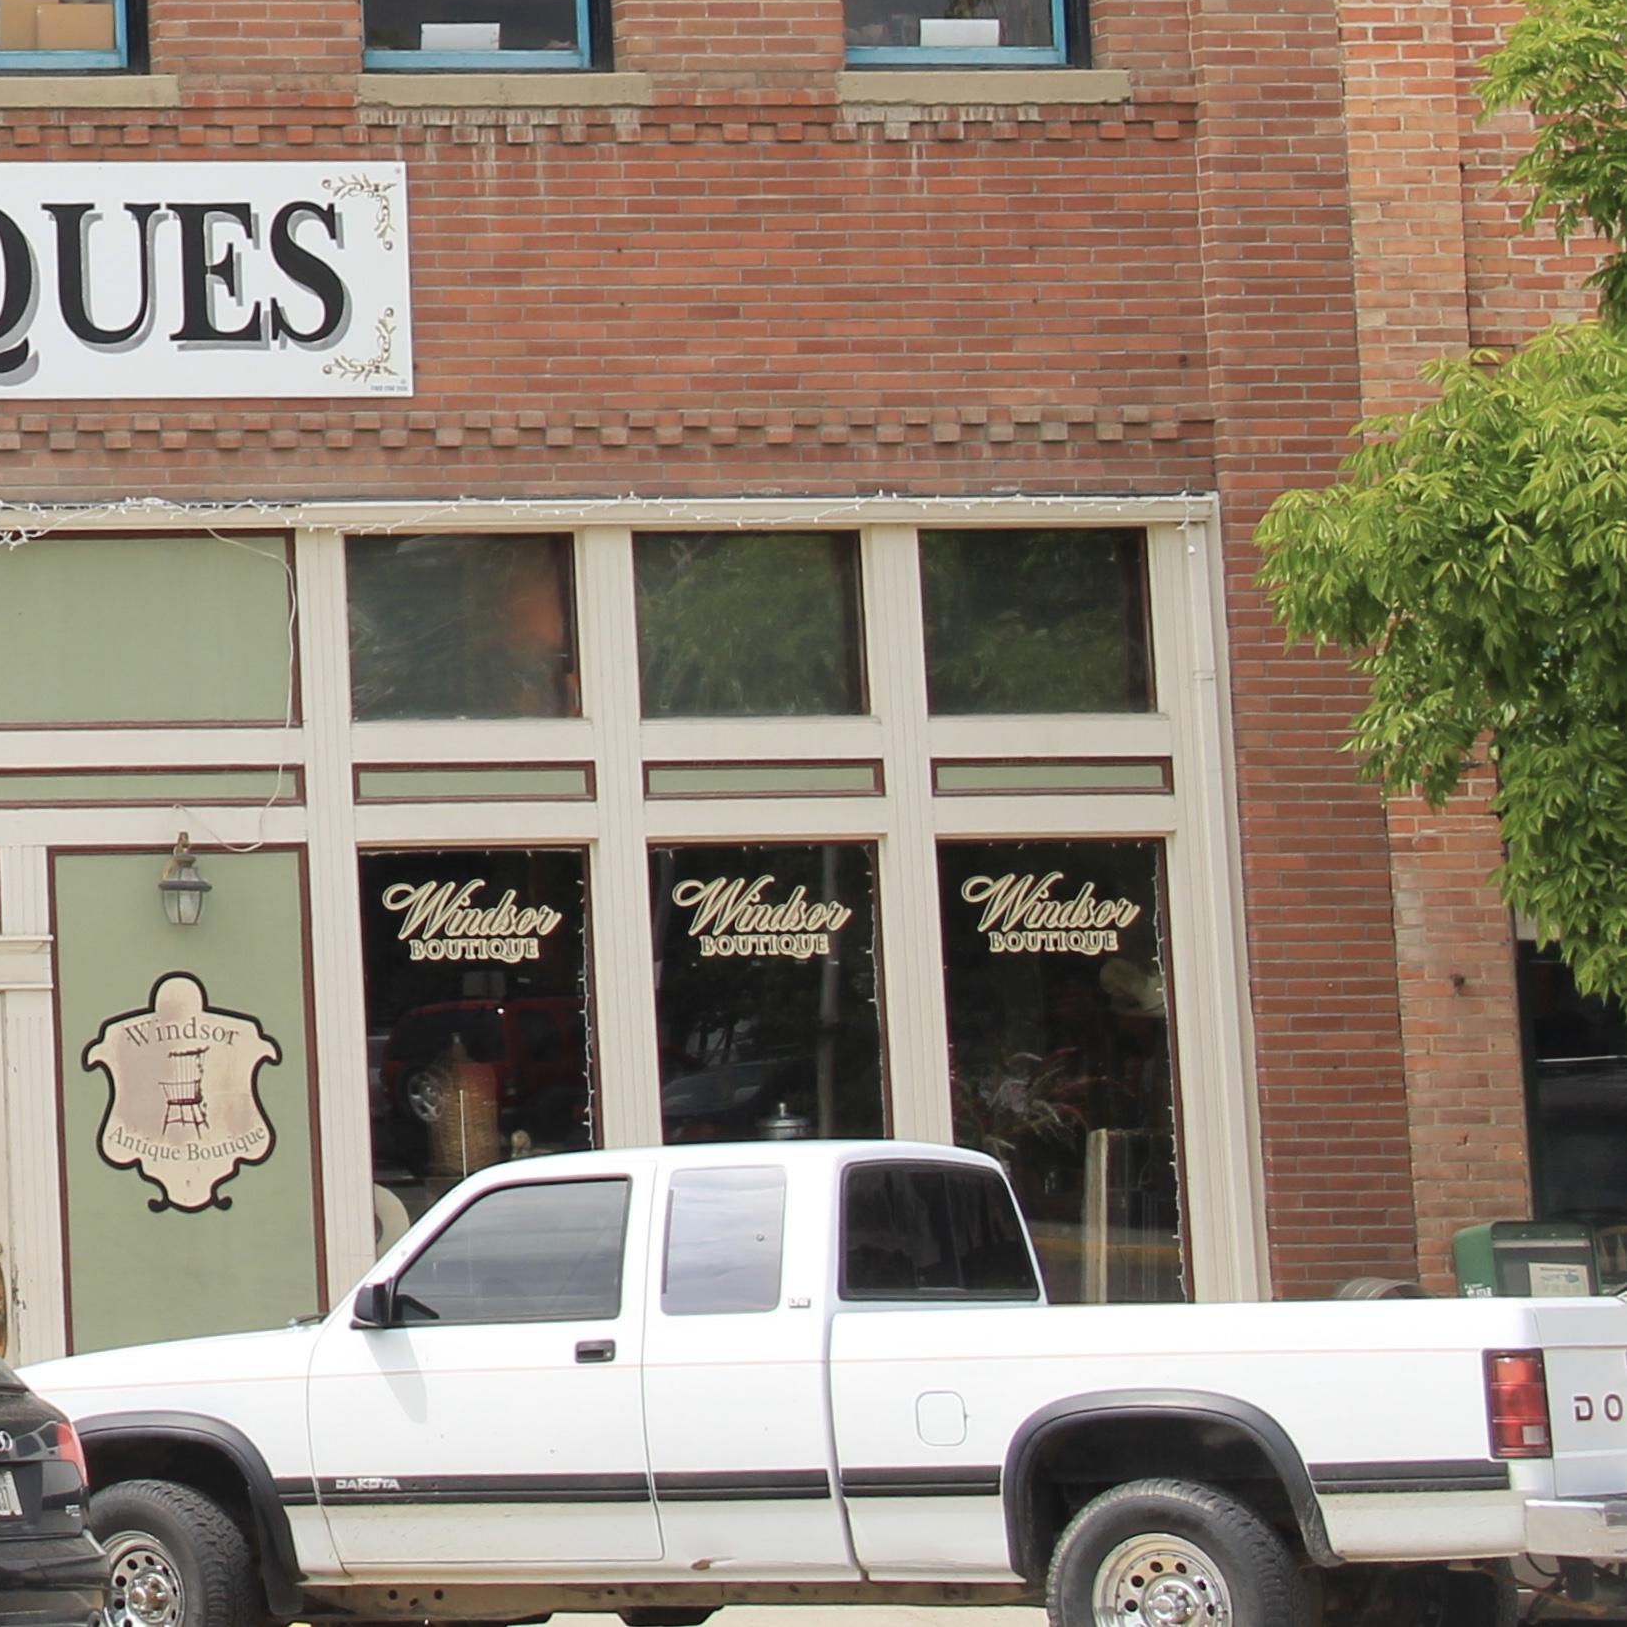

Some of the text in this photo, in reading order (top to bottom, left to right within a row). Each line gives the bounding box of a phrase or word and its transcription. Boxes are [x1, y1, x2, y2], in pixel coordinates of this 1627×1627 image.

[382, 879, 562, 940] Windsor
[672, 875, 852, 936] Windsor
[961, 871, 1141, 932] Windsor
[409, 937, 540, 963] BOUTIQUE
[699, 933, 830, 959] BOUTIQUE
[988, 929, 1119, 955] BOUTIQUE
[124, 1017, 239, 1047] Windsor
[108, 1126, 266, 1161] Antique Boutique
[1573, 1394, 1623, 1421] DO
[335, 1478, 401, 1490] DAKOTA
